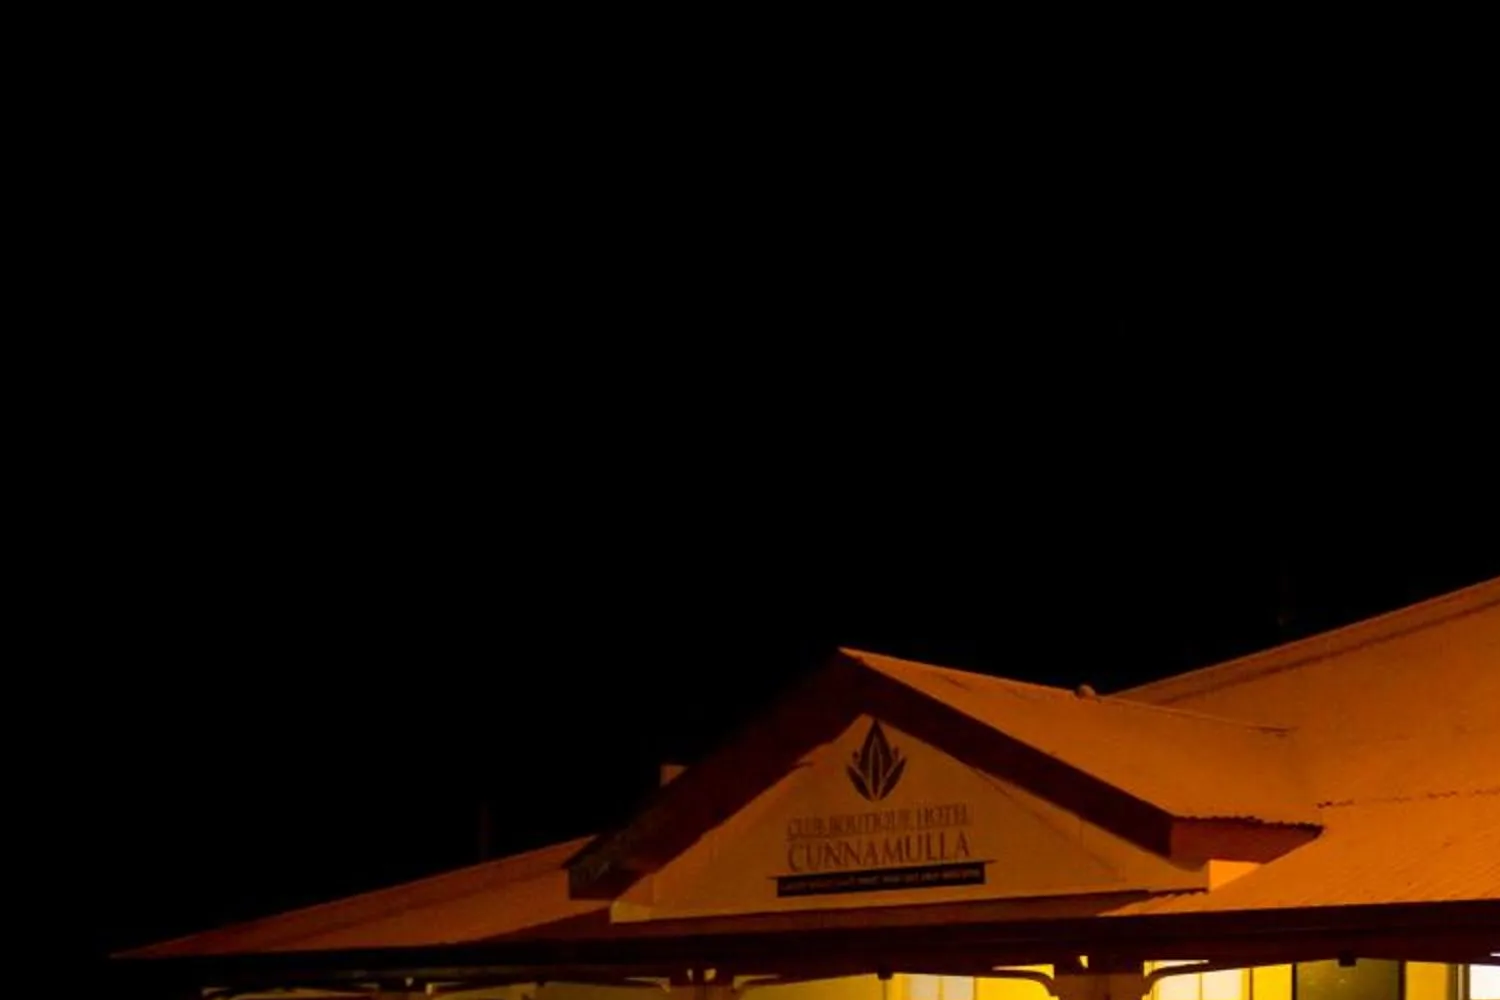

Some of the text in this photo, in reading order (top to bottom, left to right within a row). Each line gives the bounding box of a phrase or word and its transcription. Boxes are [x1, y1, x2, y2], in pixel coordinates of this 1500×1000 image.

[829, 810, 912, 835] BOUTIQUE
[916, 803, 971, 828] HOTEL
[787, 830, 971, 872] CUNNAMULLA
